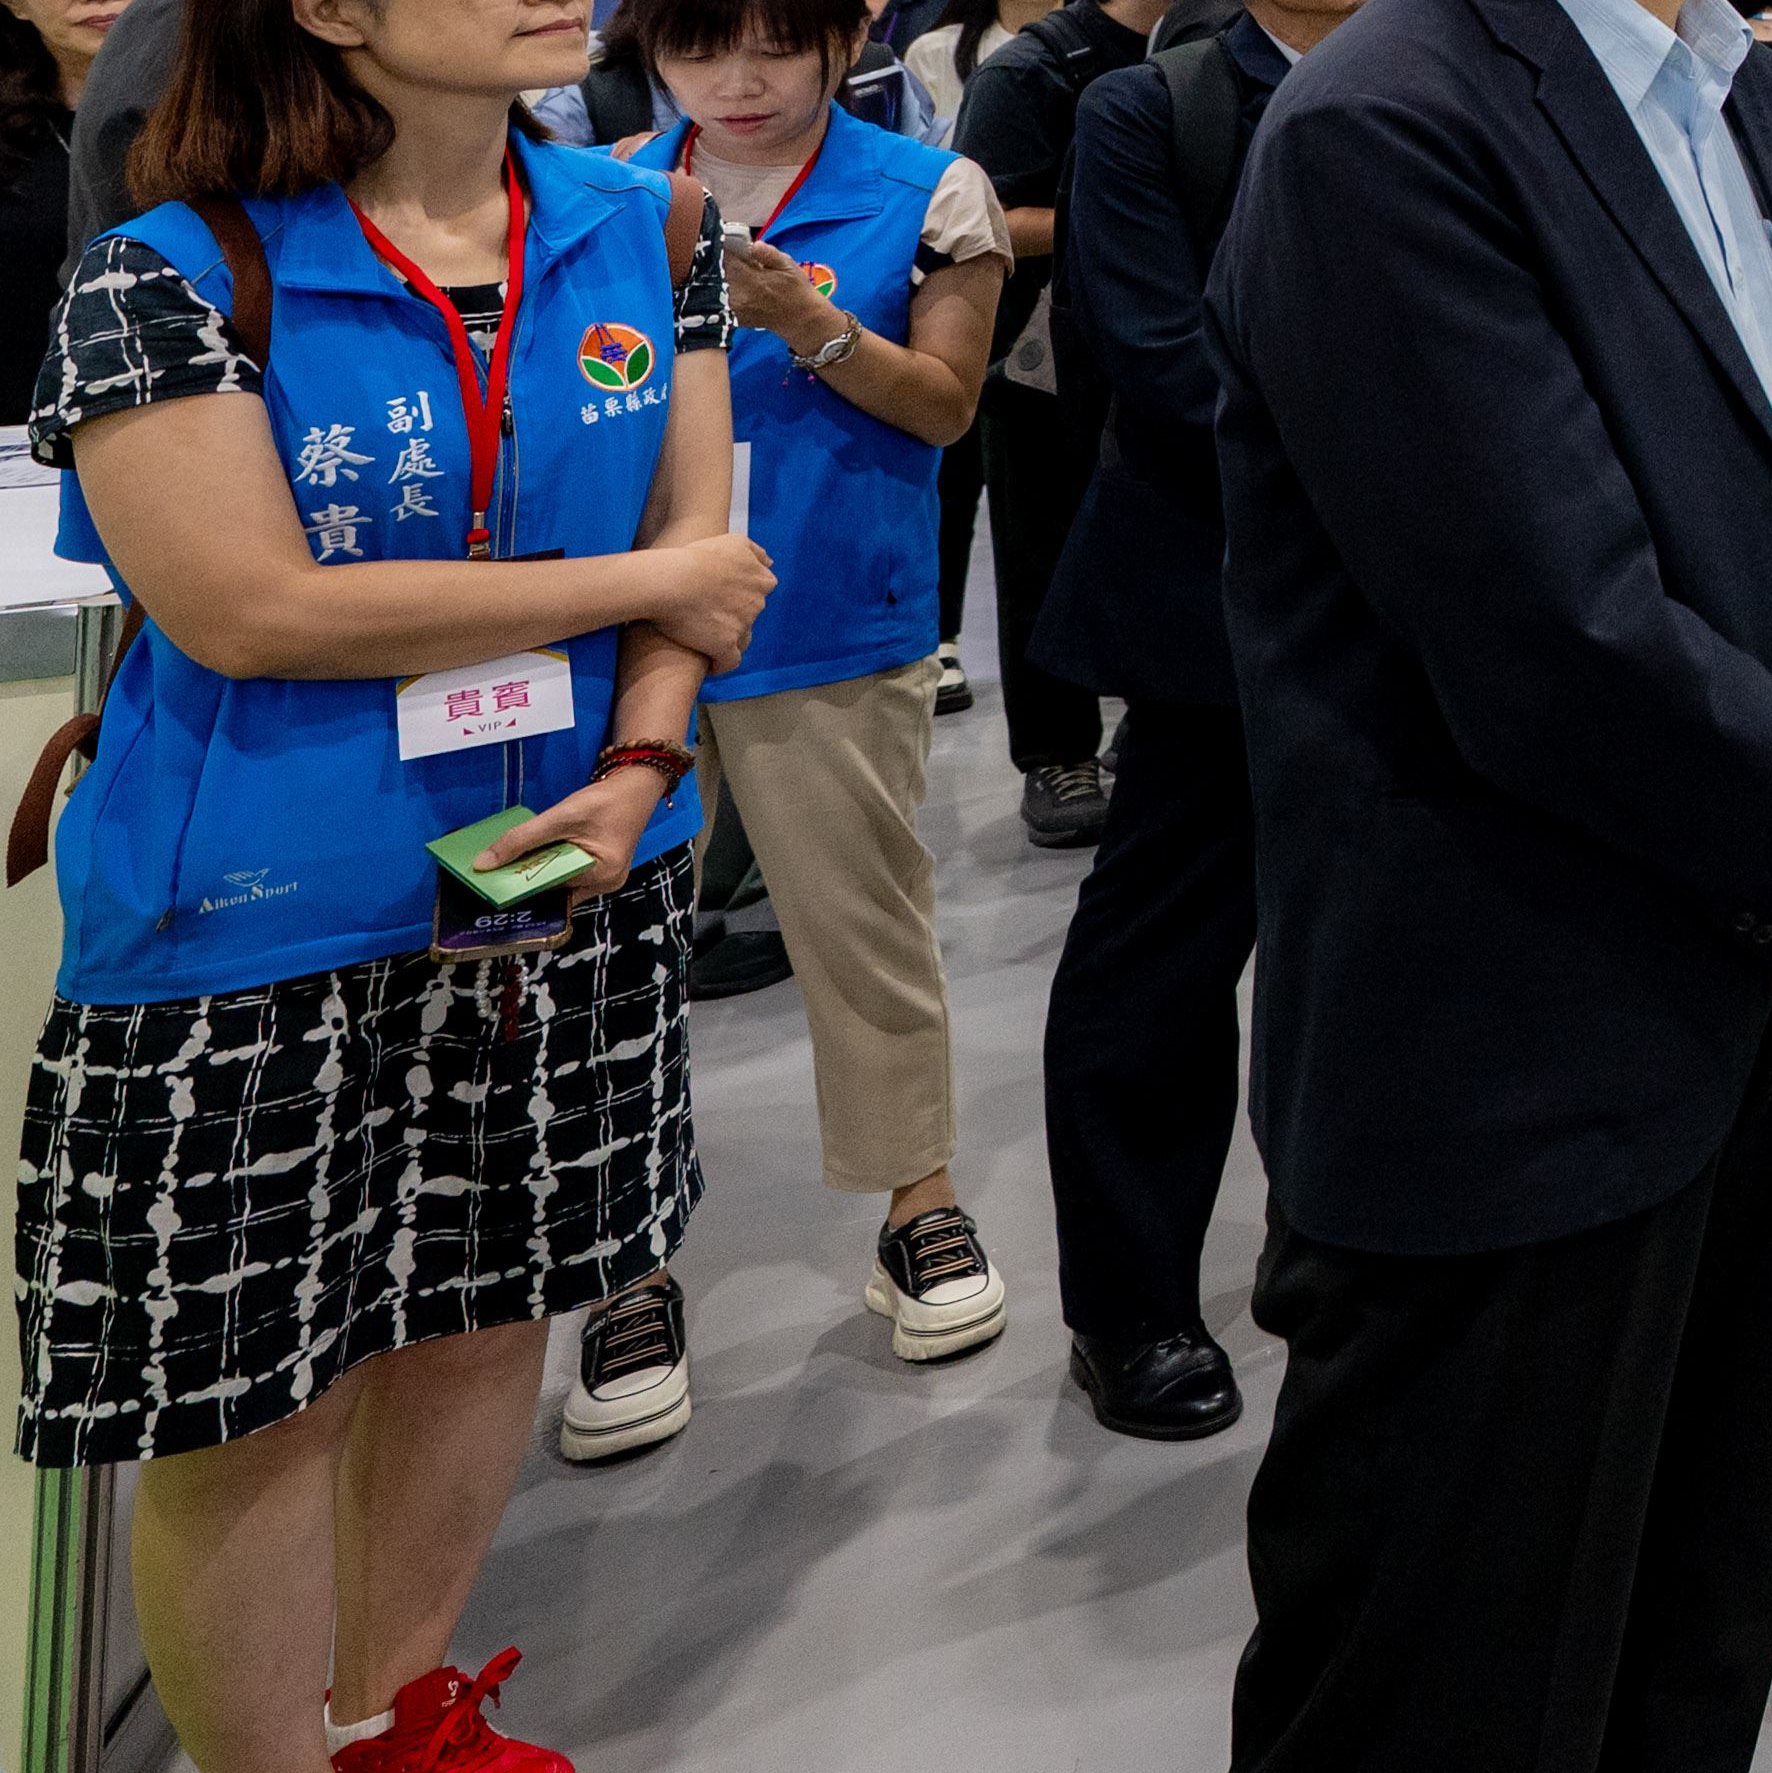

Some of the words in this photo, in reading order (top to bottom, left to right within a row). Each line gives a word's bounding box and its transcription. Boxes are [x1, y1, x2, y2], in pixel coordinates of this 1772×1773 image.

[386, 390, 445, 522] 副處長
[443, 679, 531, 723] 貴賓
[478, 720, 503, 733] VIP
[250, 880, 299, 901] Sport
